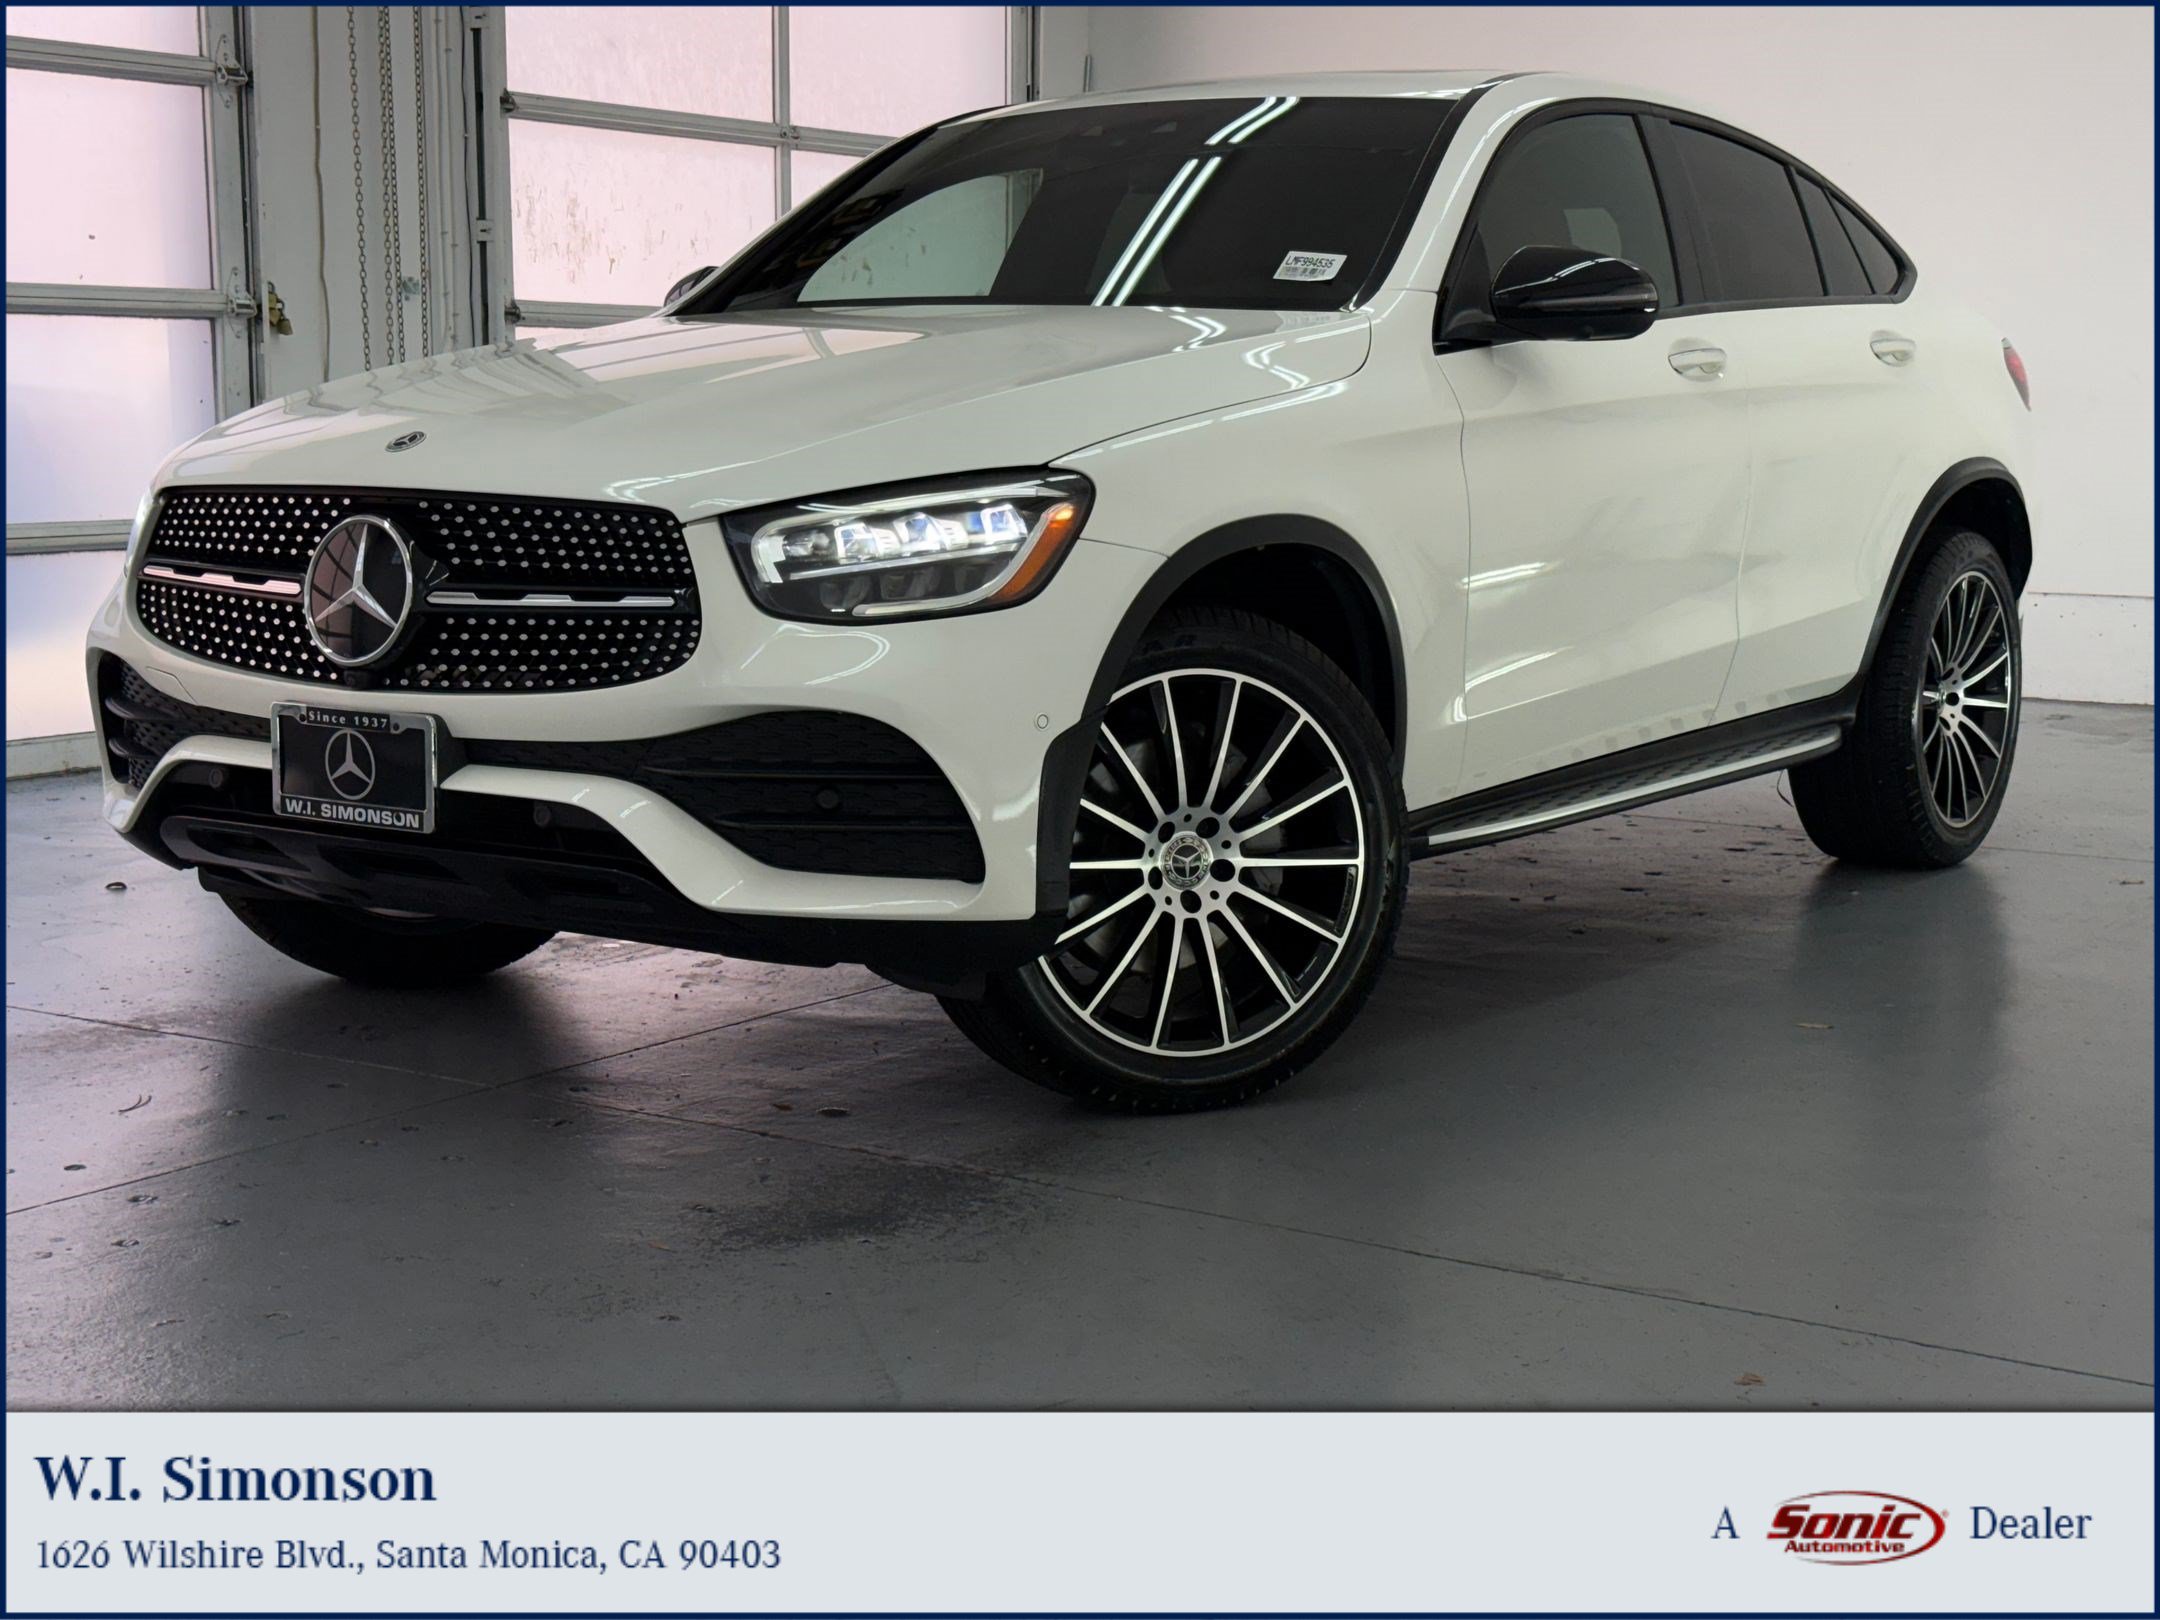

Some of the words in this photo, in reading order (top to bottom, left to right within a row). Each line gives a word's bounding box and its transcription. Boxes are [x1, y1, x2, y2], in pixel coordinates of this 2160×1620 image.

[308, 710, 346, 725] Since
[353, 716, 388, 729] 1937
[285, 798, 316, 817] W.I.
[320, 803, 420, 829] SIMONSON
